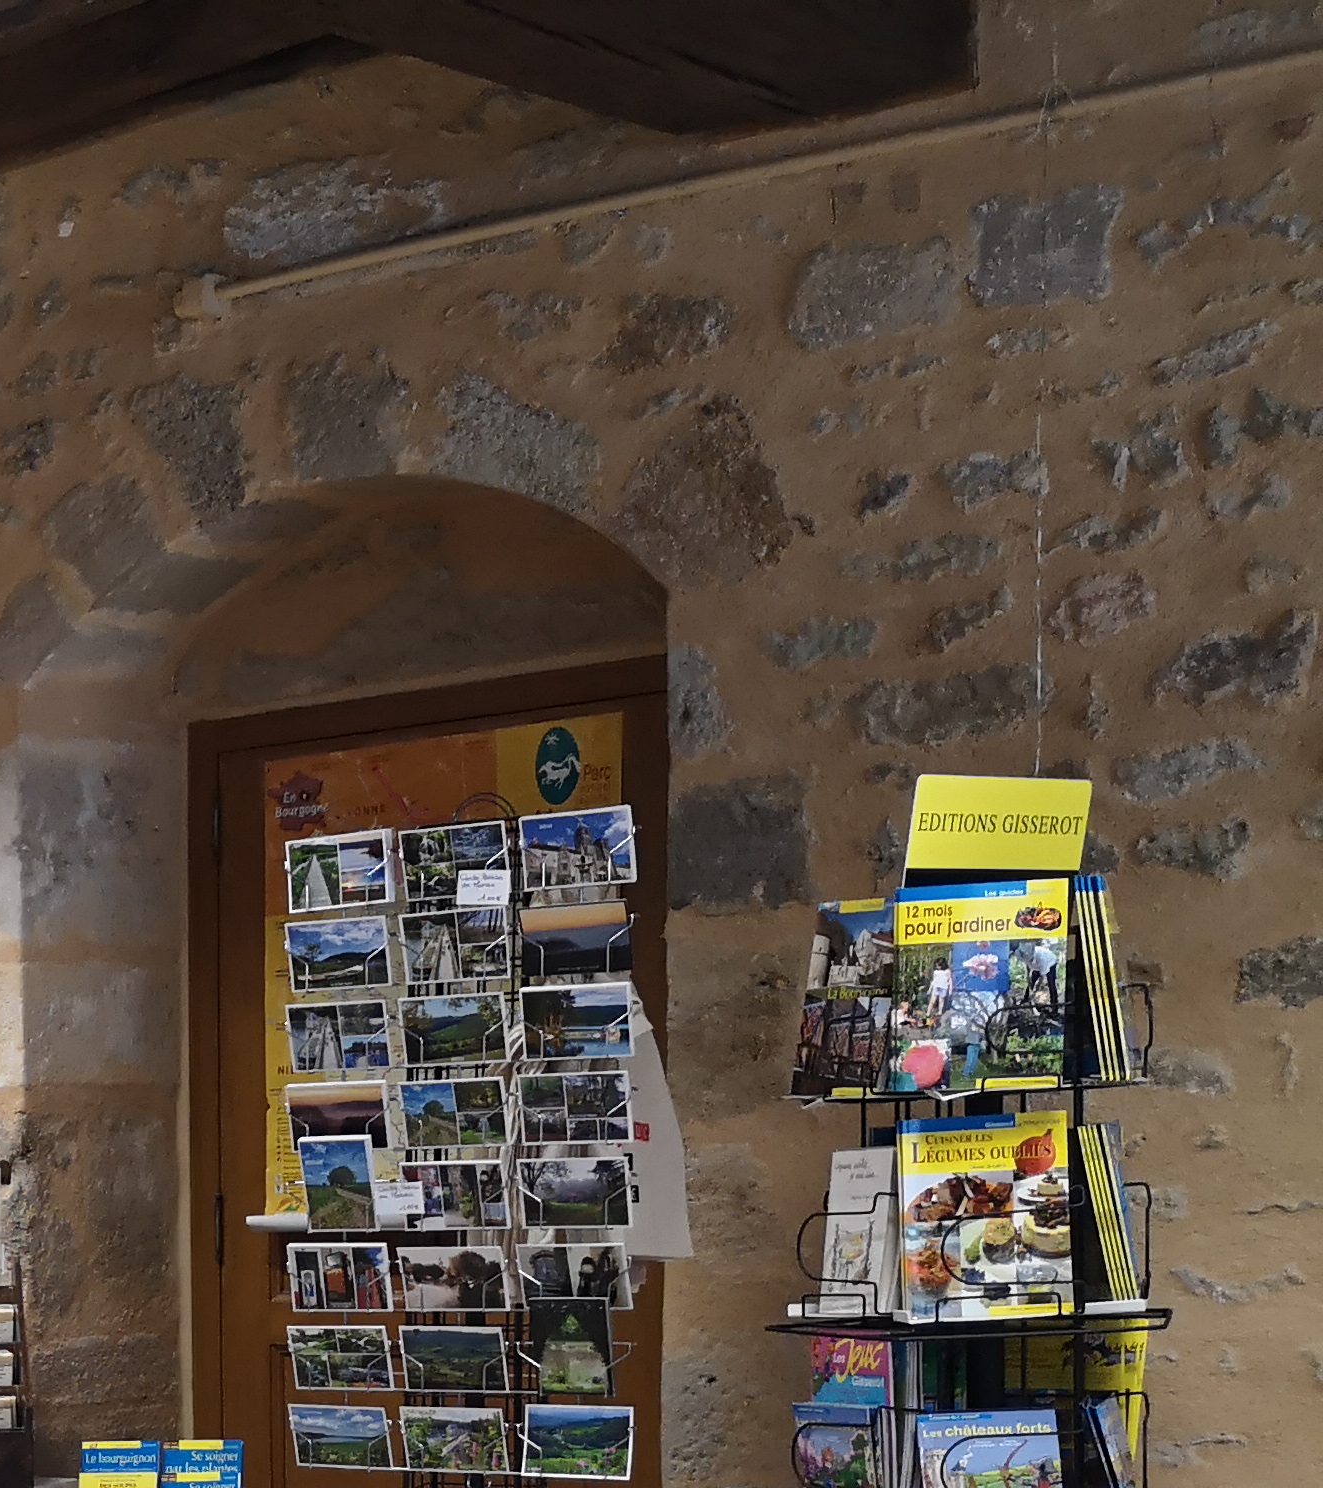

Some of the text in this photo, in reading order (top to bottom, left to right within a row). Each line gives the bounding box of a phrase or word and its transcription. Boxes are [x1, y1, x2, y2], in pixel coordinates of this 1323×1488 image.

[583, 764, 611, 781] Parc
[274, 803, 329, 818] Bourgogne
[918, 812, 1083, 835] EDITIONS GISSEROT
[904, 903, 953, 919] 12 mois
[904, 915, 1011, 940] pour jardiner
[925, 1133, 994, 1144] CUISINER LES
[911, 1141, 1053, 1164] LÉGUMES OUBLIÉS
[944, 1421, 1013, 1437] châteaux
[1015, 1422, 1053, 1434] forts
[85, 1452, 155, 1466] Le bourguignon
[191, 1451, 238, 1464] Se soigner
